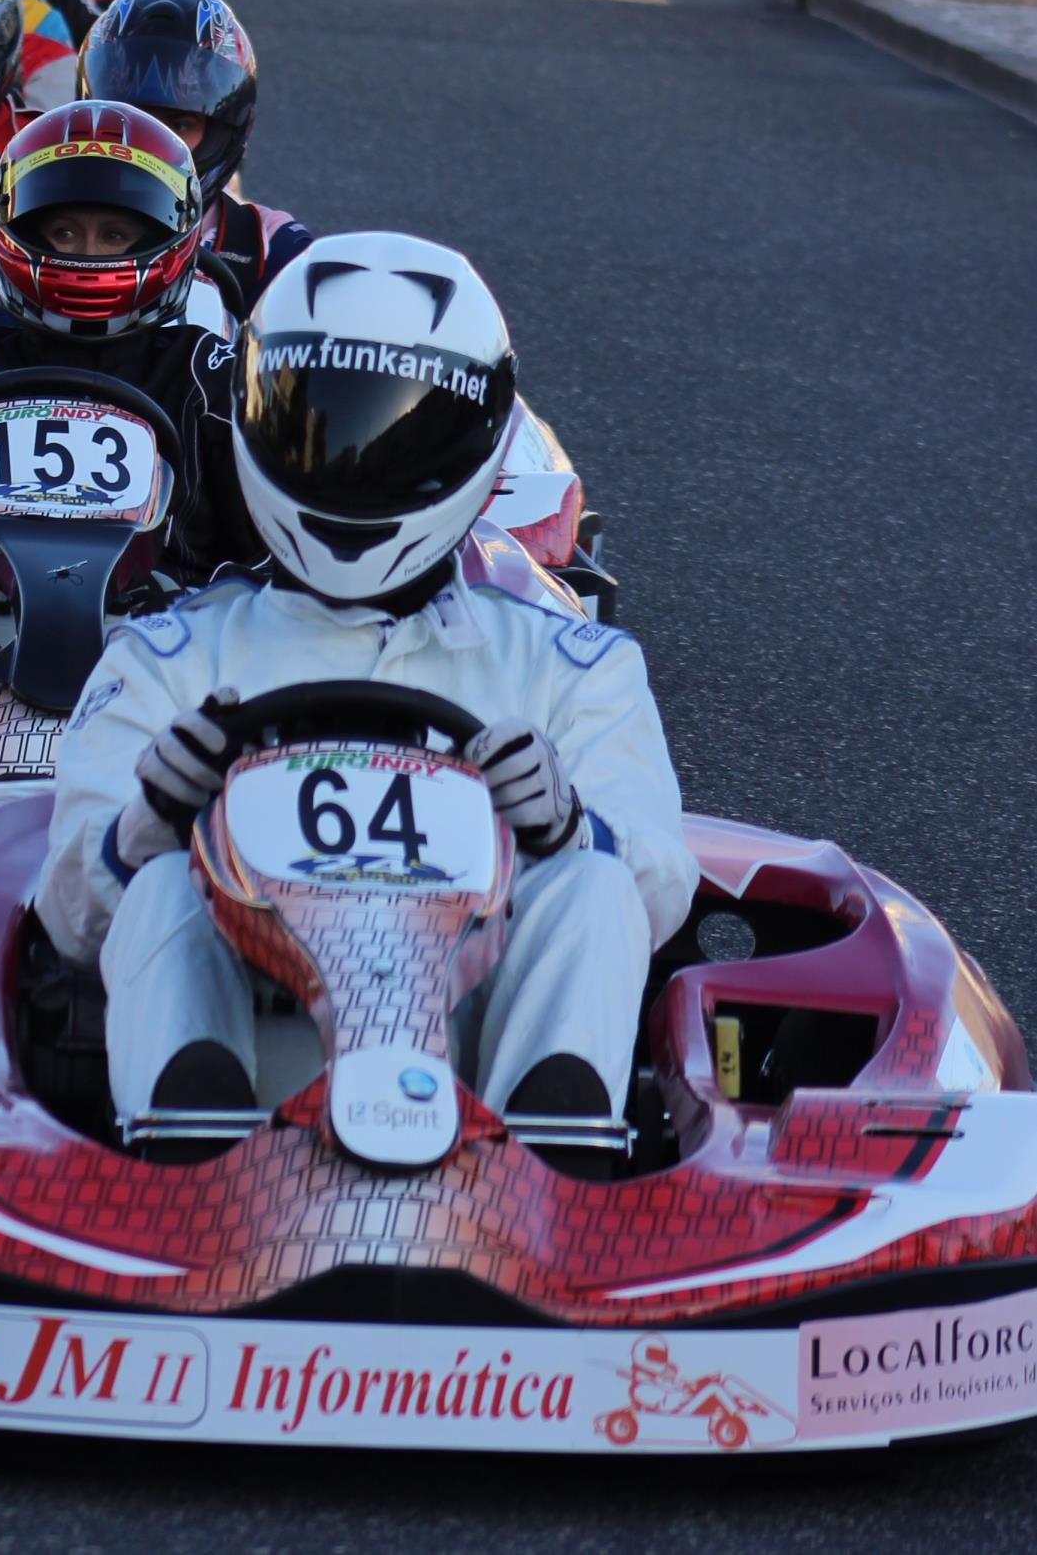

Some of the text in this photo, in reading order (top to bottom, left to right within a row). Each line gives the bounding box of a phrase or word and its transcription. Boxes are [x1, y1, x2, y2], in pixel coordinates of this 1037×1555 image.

[54, 142, 132, 161] GAS
[258, 338, 488, 406] www.funkart.net
[286, 753, 443, 778] EUROINDY
[298, 769, 427, 863] 64
[372, 1100, 439, 1131] Spirit
[143, 1352, 195, 1405] II
[225, 1342, 575, 1434] Informática
